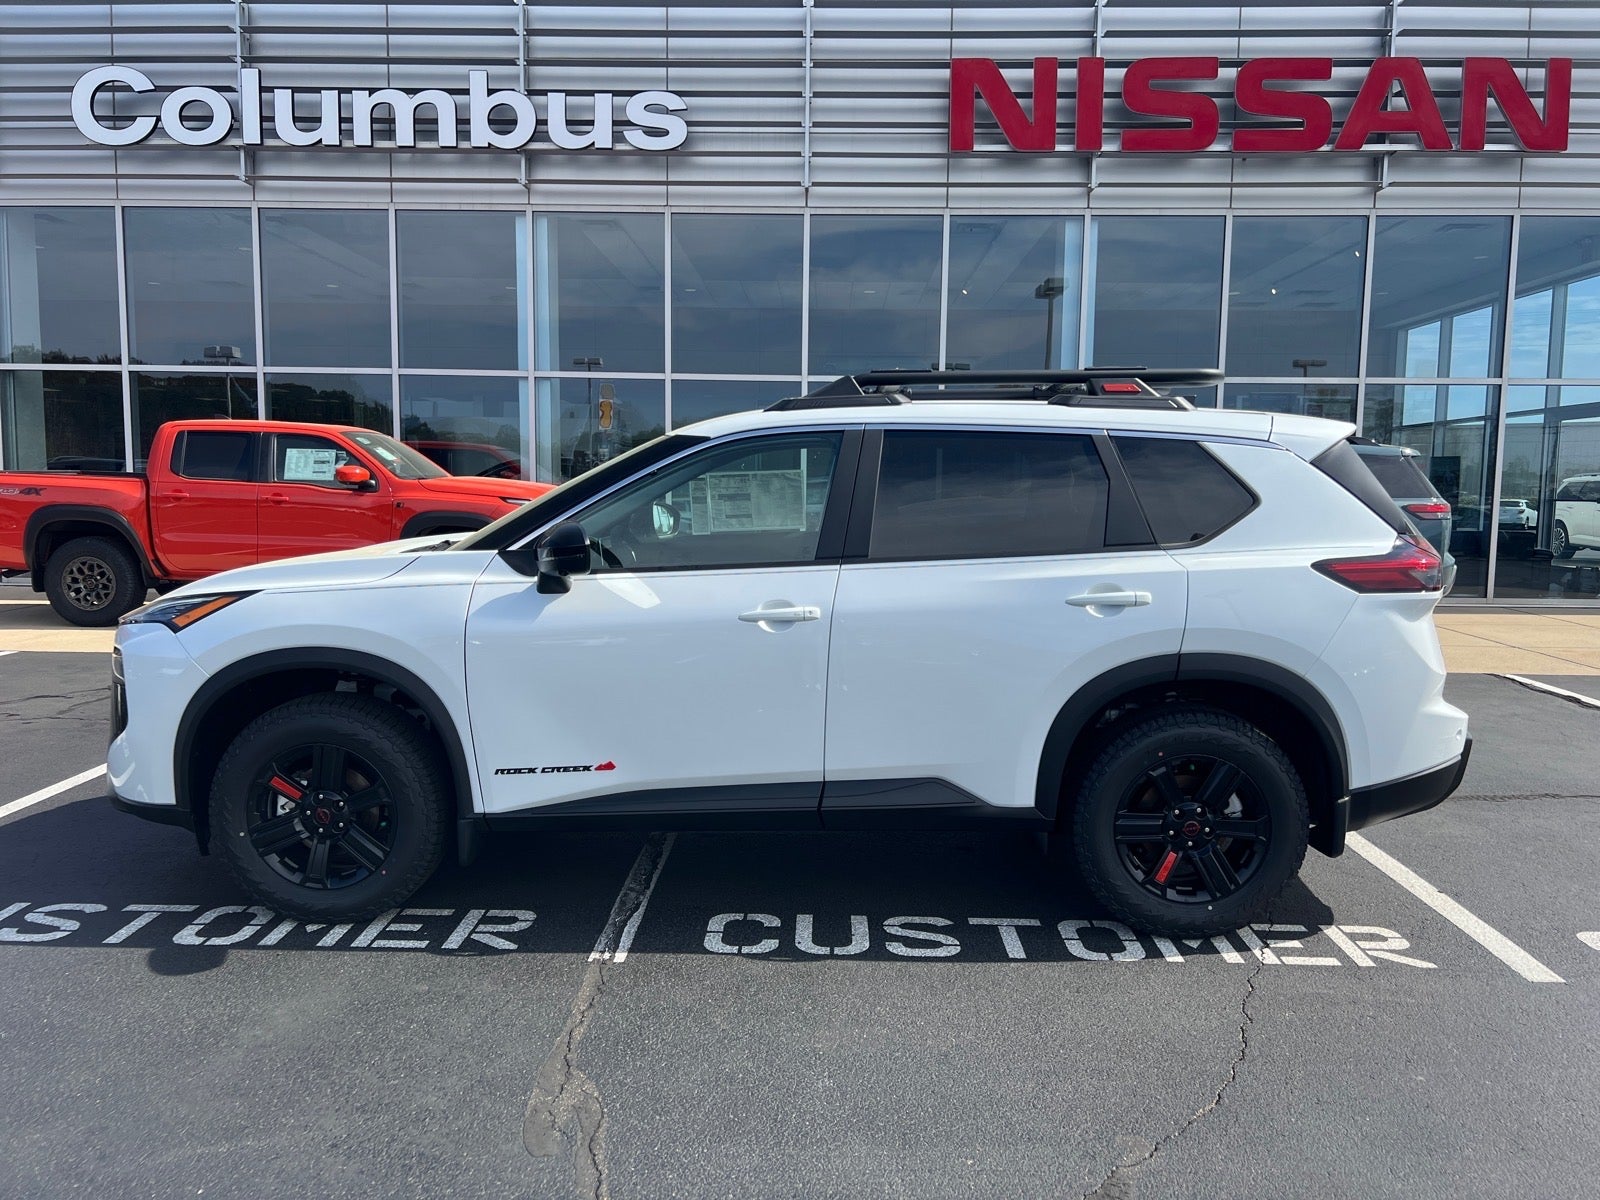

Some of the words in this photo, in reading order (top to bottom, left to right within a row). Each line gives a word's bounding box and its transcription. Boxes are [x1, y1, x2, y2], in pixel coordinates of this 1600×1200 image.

[71, 64, 689, 151] Columbus
[949, 56, 1573, 153] NISSAN
[494, 767, 539, 775] ROCK
[540, 765, 594, 773] CREEK
[703, 913, 1438, 969] CUSTOMER
